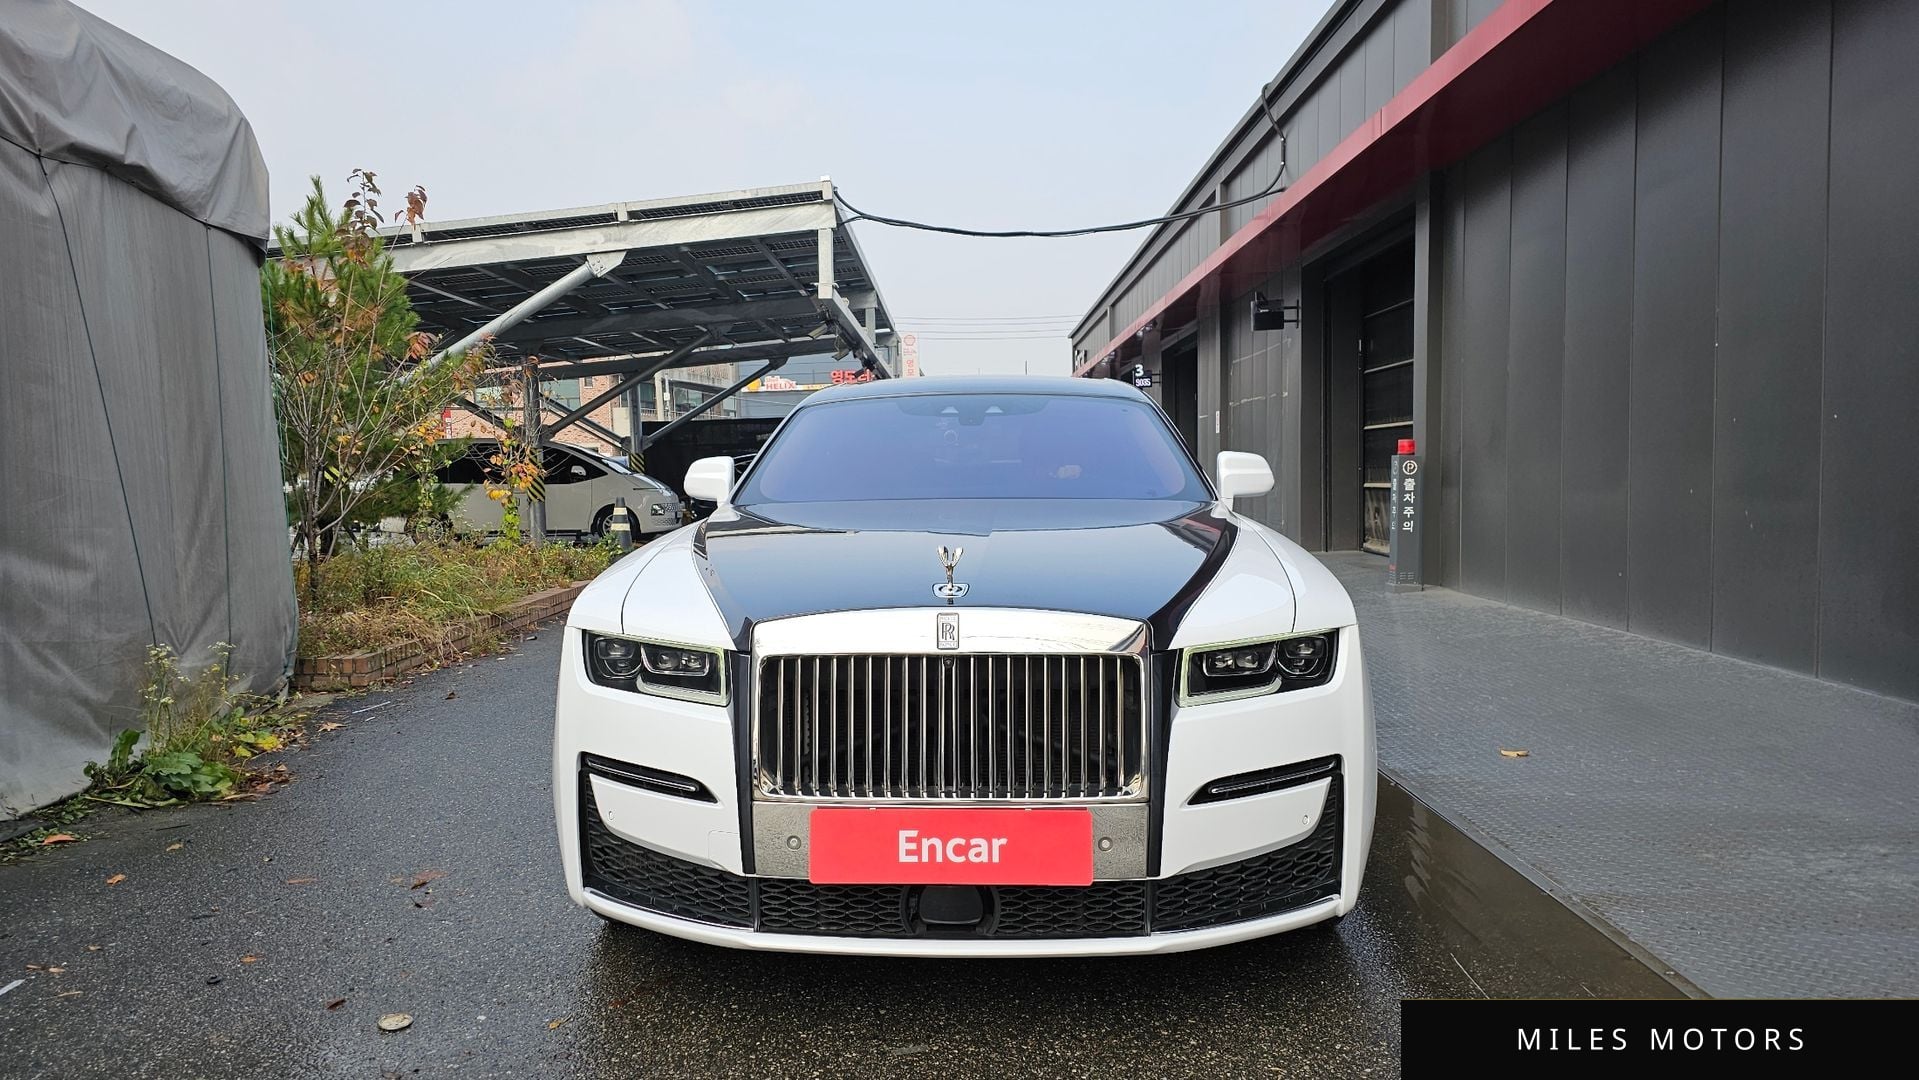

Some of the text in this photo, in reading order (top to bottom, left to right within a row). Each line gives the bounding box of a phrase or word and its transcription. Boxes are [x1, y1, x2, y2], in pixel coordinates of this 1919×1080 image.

[1135, 364, 1144, 377] 3
[766, 382, 796, 391] HELIX
[1402, 478, 1415, 533] 출차주의
[898, 829, 1008, 864] Encar
